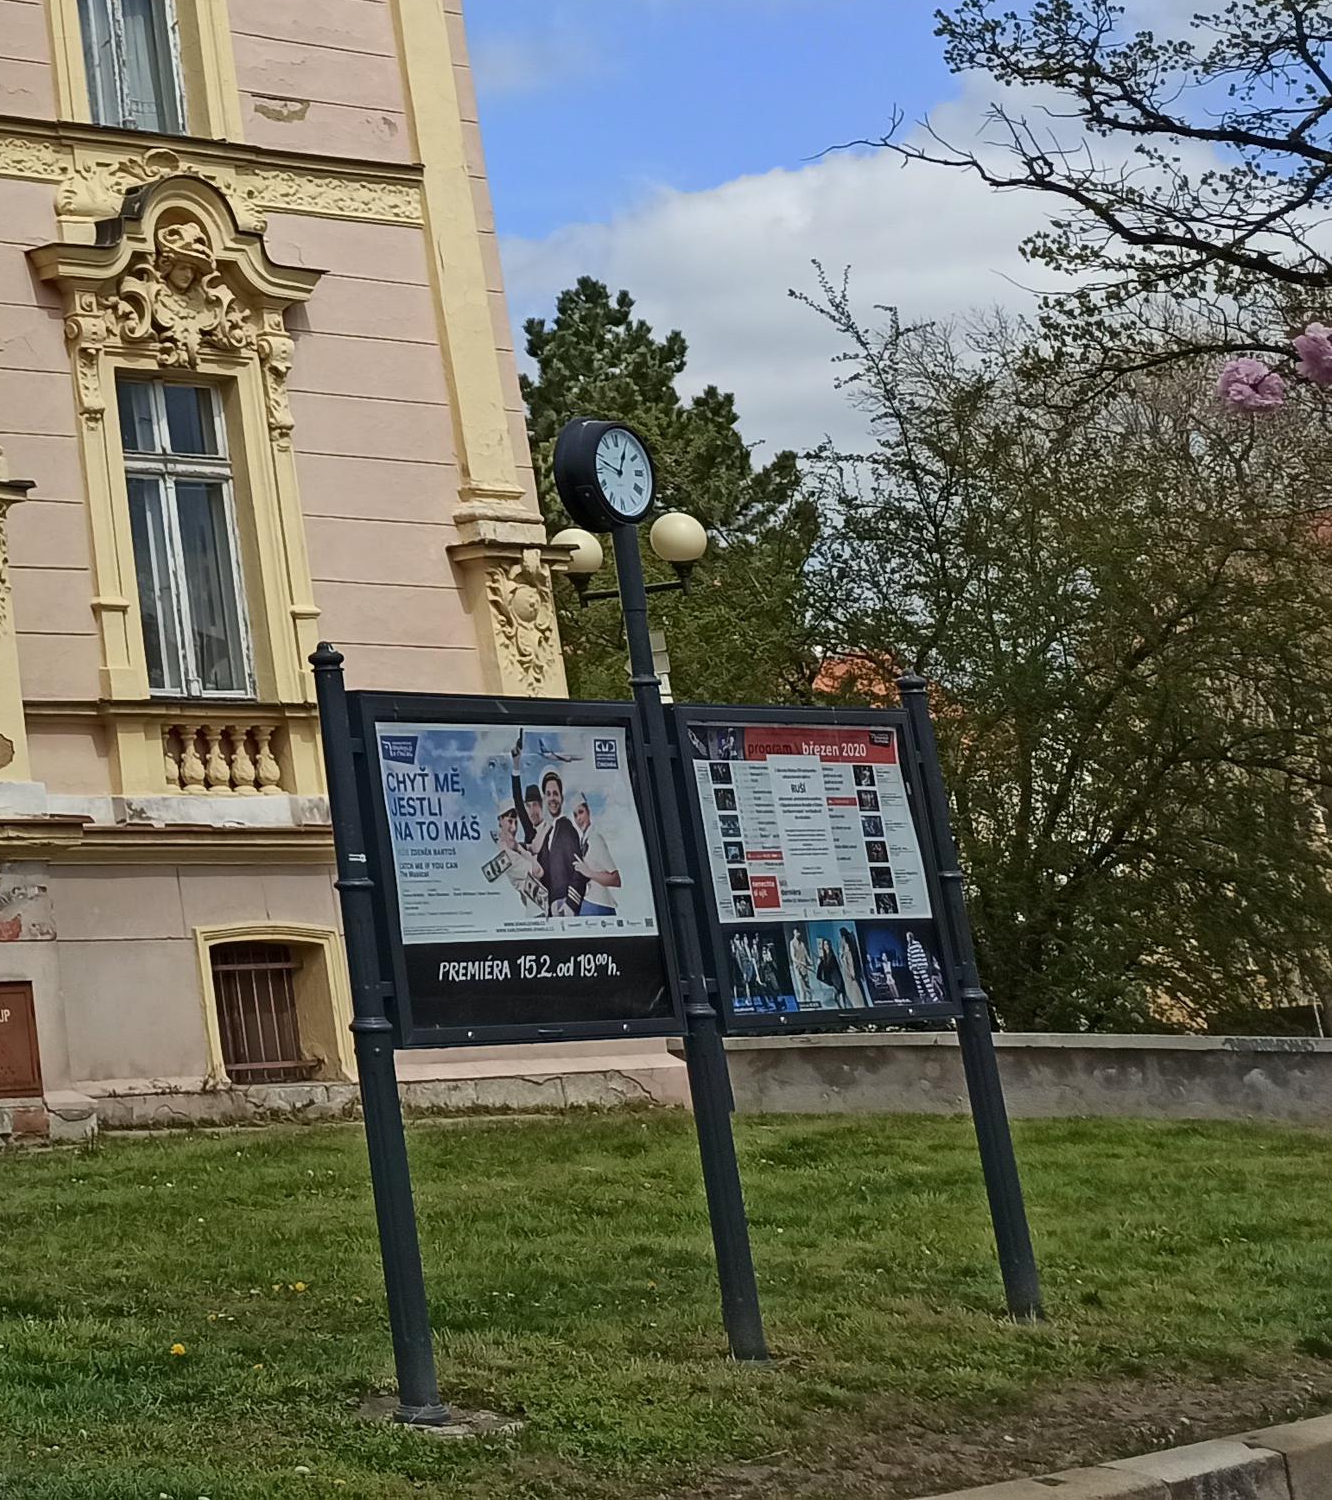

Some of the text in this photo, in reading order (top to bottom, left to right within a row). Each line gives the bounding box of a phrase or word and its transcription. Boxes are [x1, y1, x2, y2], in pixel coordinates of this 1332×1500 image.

[747, 741, 867, 757] program březen 2020
[386, 766, 465, 796] CHYŤ MĚ,
[390, 797, 443, 817] JESTLI
[393, 815, 481, 841] NA TO MÁŠ
[438, 955, 512, 982] PREMIÉRA
